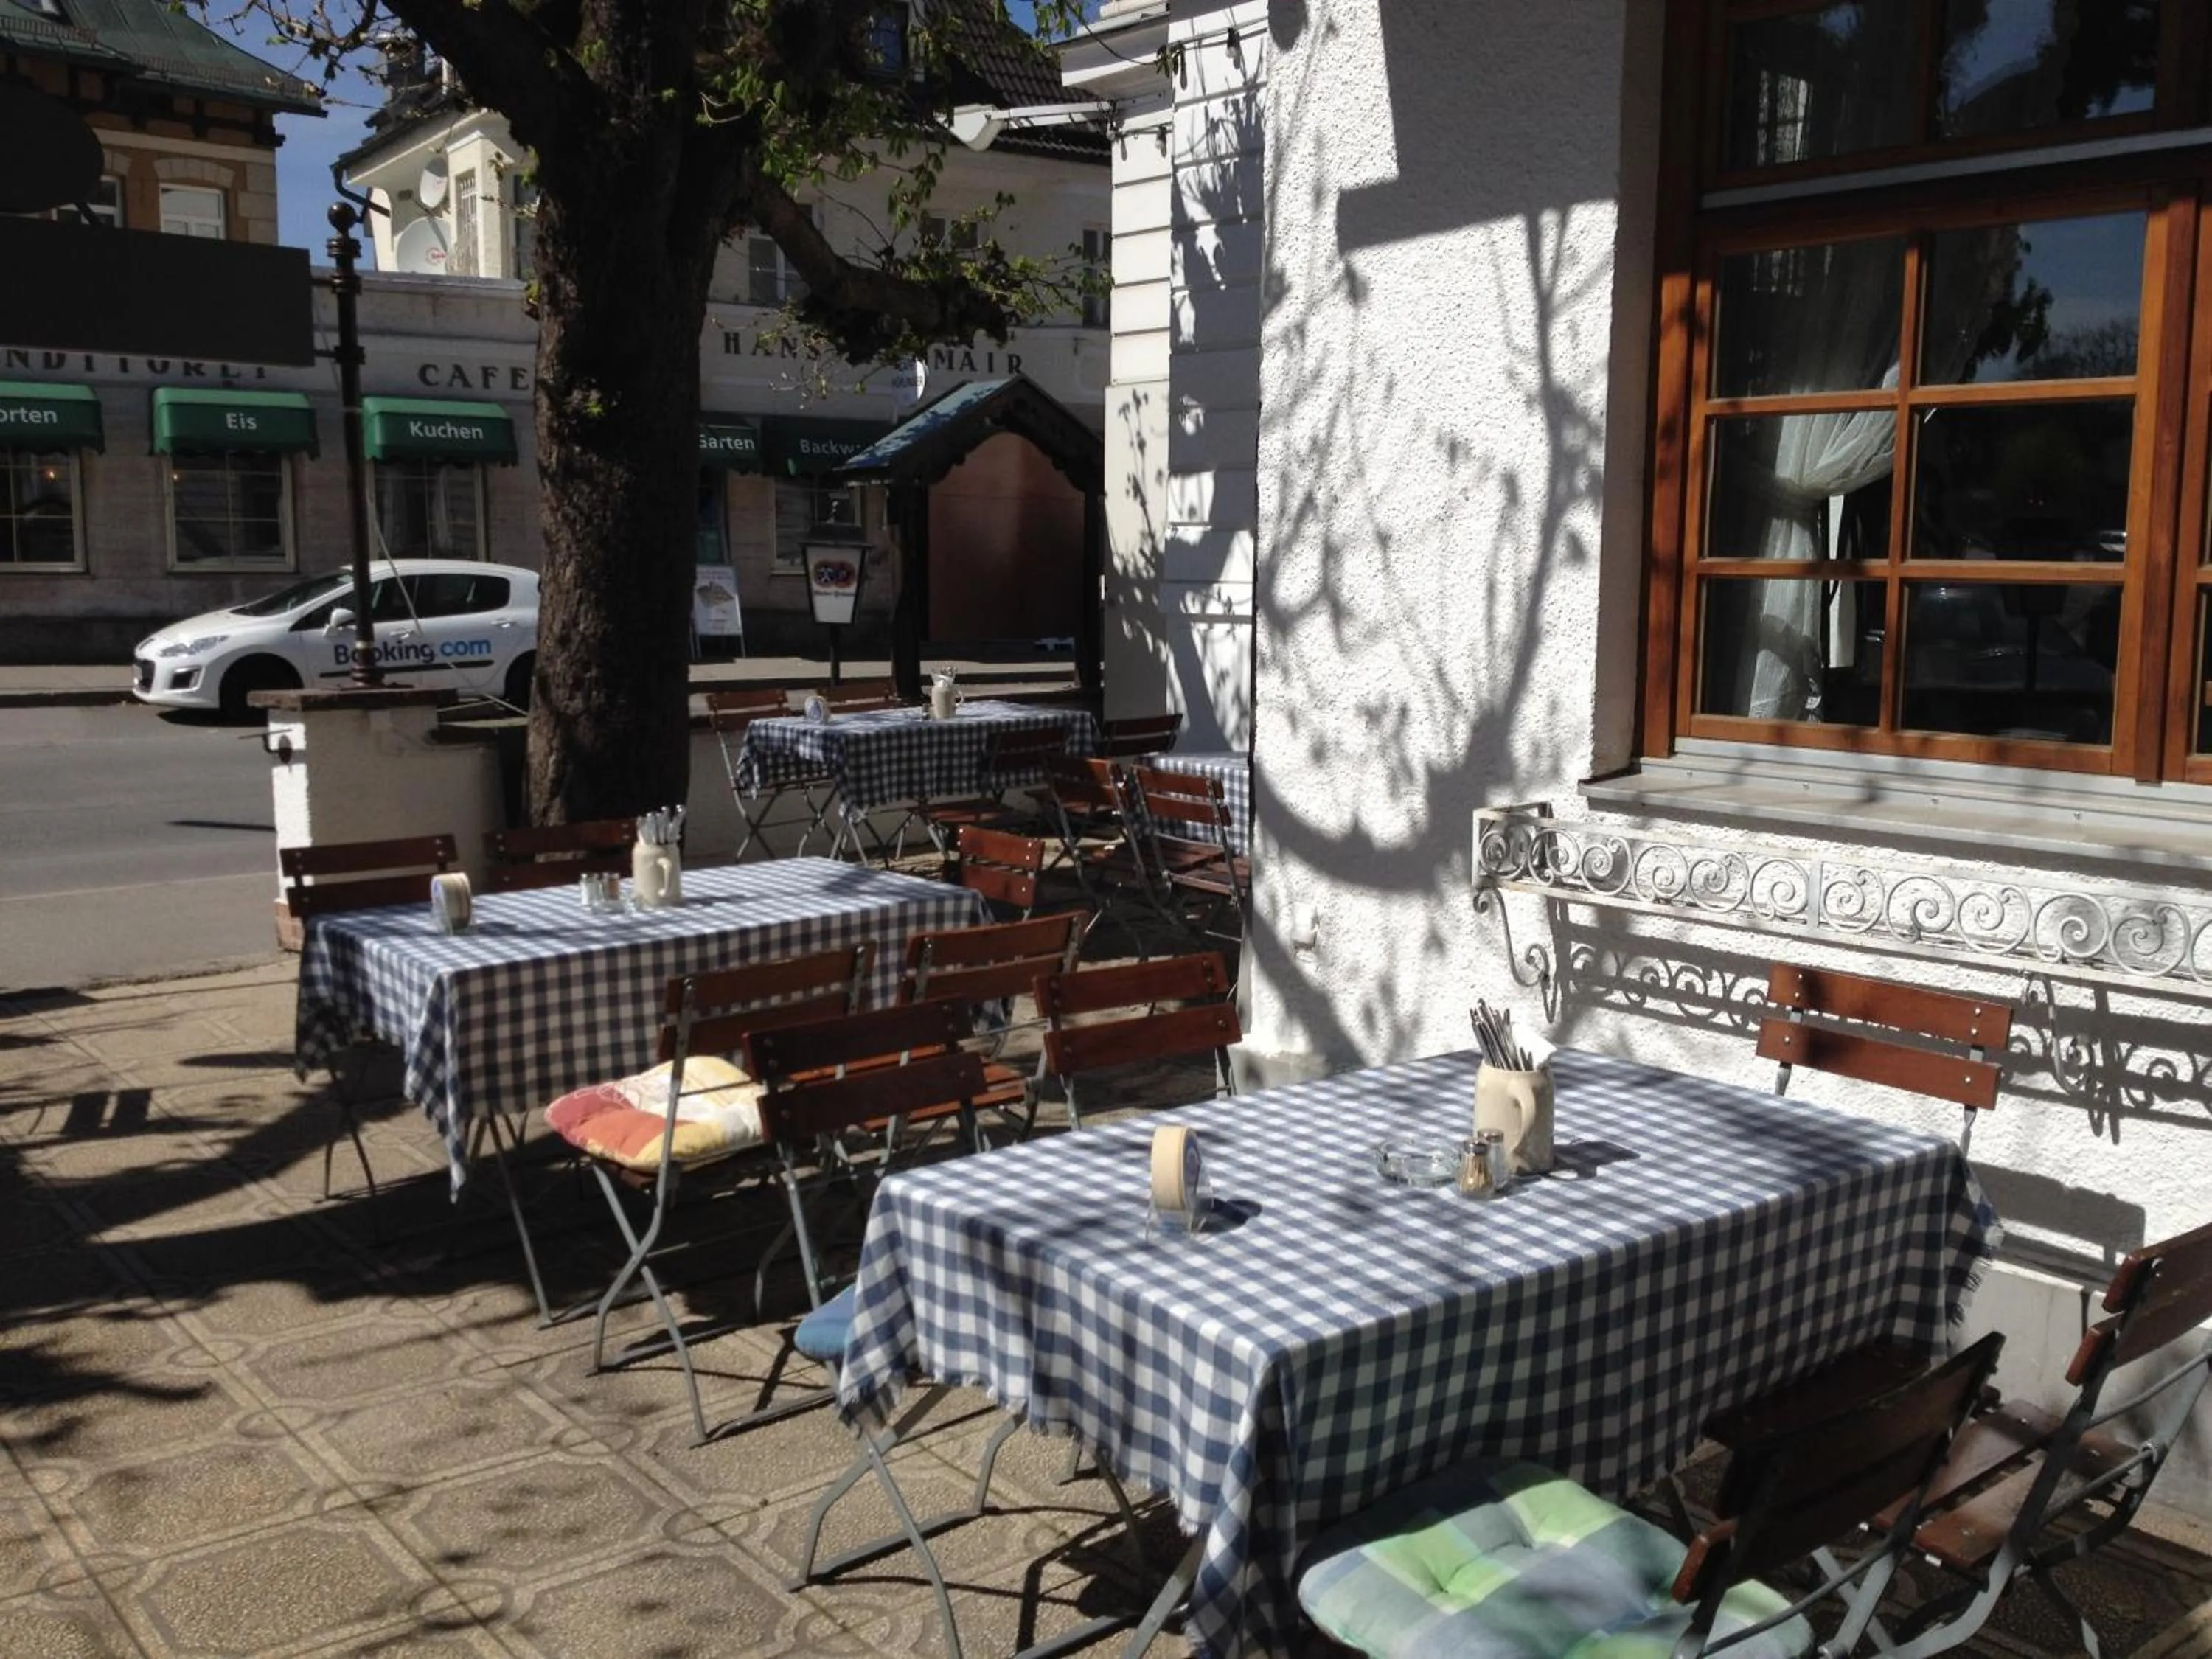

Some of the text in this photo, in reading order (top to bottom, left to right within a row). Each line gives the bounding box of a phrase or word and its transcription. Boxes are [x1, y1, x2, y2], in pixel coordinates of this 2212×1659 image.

[226, 412, 257, 431] Eis
[409, 420, 484, 440] Kuchen
[800, 439, 861, 455] Backw
